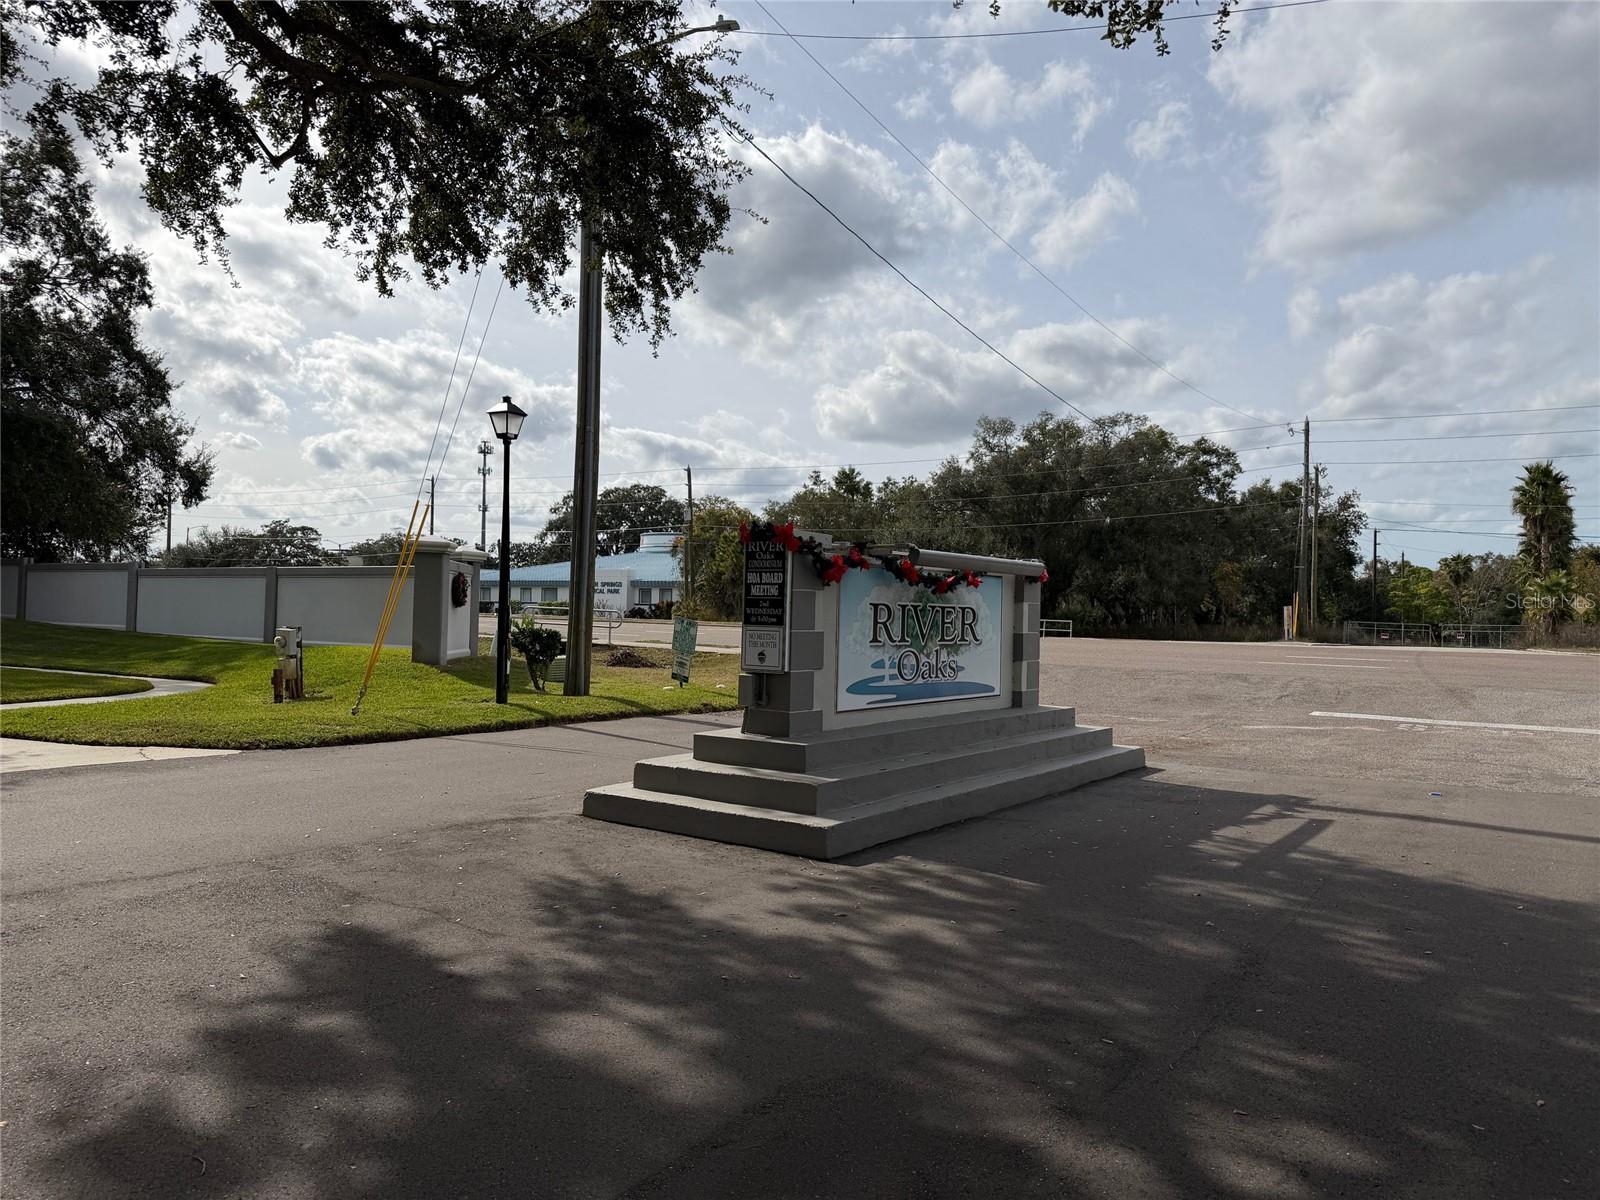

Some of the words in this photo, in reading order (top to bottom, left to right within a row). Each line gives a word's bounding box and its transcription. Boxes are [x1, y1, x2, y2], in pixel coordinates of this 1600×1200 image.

[748, 541, 784, 552] RIVER
[756, 551, 775, 560] Oaks
[747, 572, 761, 584] HOA
[762, 572, 783, 584] BOARD
[750, 584, 779, 596] MEETING
[746, 607, 783, 615] WEDNESDAY
[869, 602, 982, 646] RIVER
[896, 646, 958, 682] Oaks
